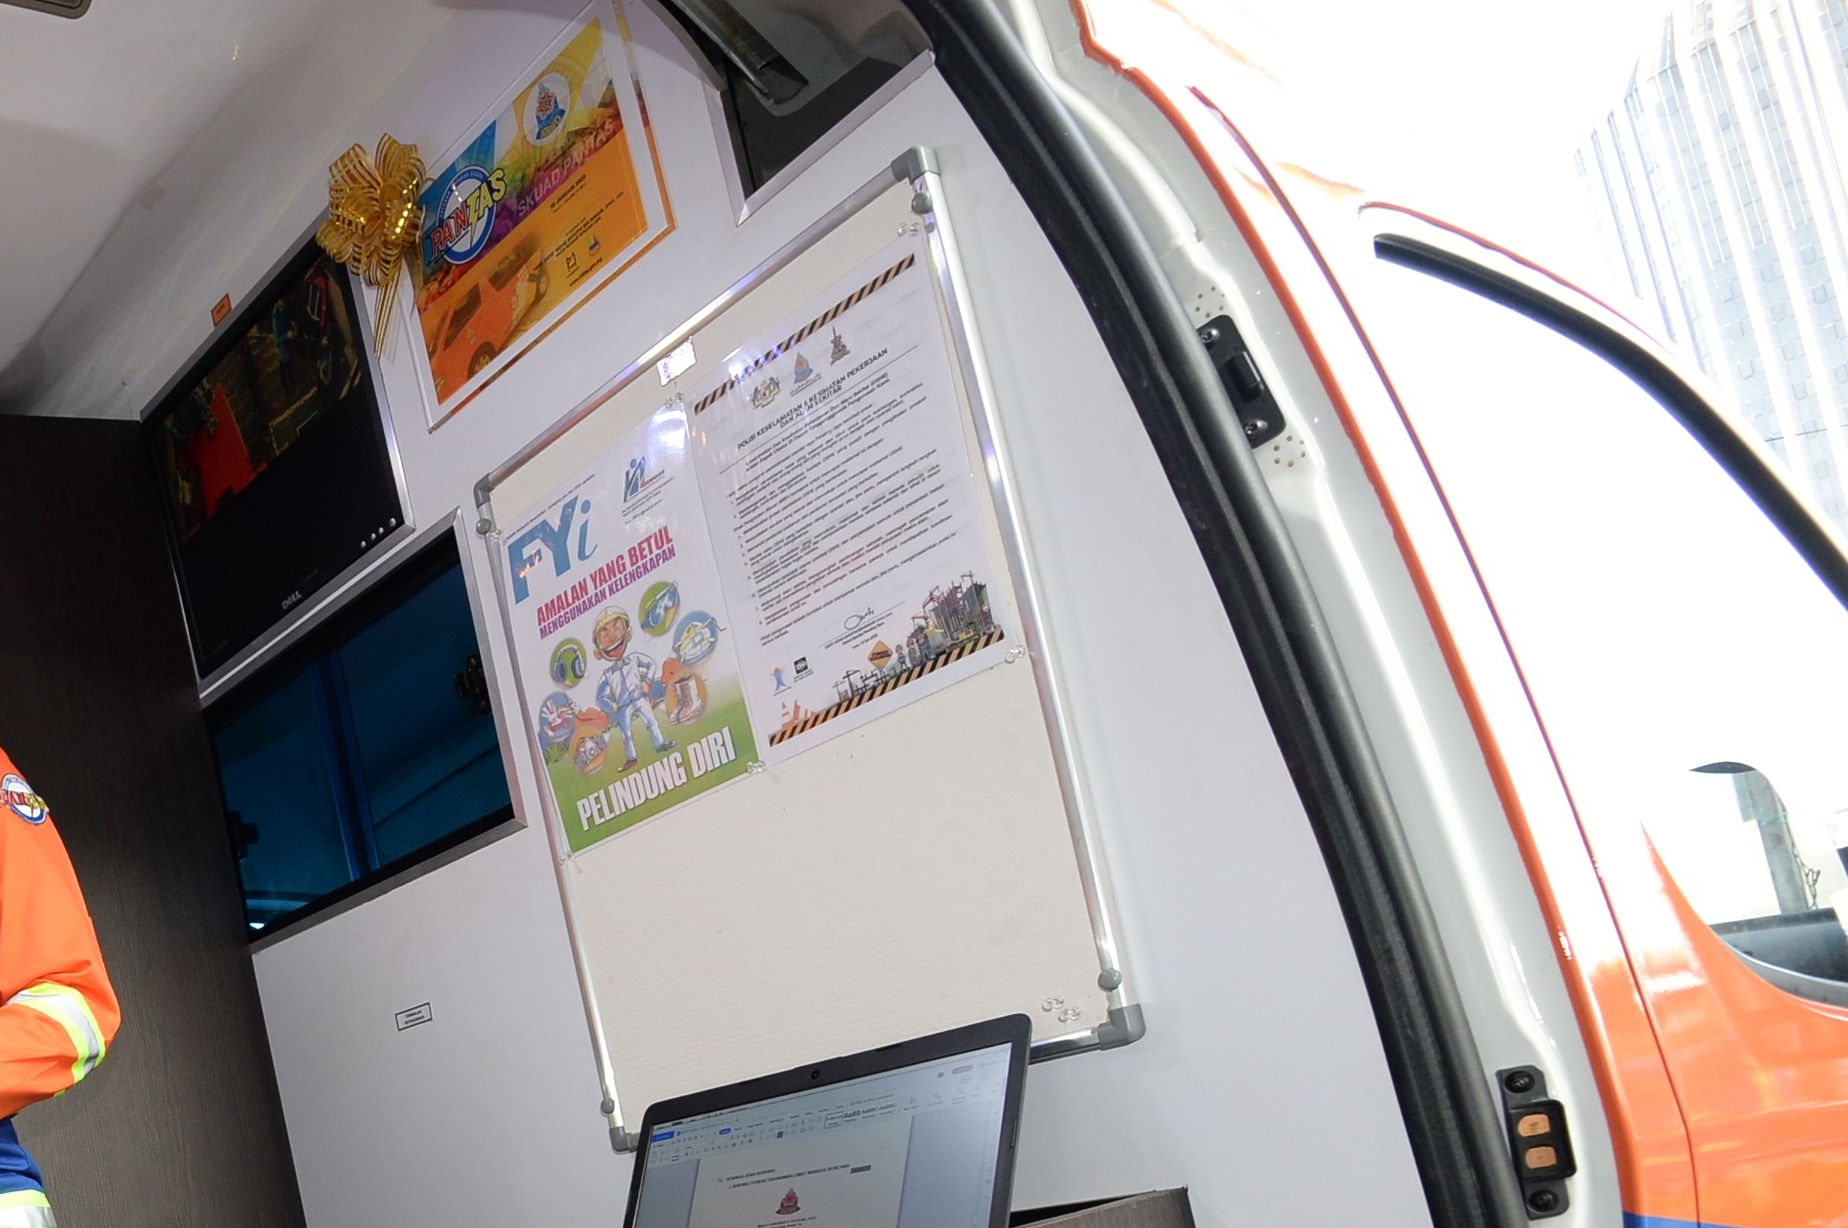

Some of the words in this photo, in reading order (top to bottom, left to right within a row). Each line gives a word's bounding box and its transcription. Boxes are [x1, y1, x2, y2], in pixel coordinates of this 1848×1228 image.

[430, 167, 507, 258] PANTAS
[518, 173, 562, 218] SKUAD
[563, 119, 614, 173] PANTAS
[756, 404, 802, 437] KESELAMATAN
[846, 348, 887, 379] PEKERJAAN
[282, 590, 303, 610] DELL
[536, 577, 588, 626] AMALAN
[590, 553, 626, 591] YANG
[627, 522, 672, 567] BETUL
[539, 586, 606, 640] MENGGUNAKAN
[607, 543, 675, 596] KELENGKAPAN
[576, 752, 687, 831] PELINDUNG
[687, 726, 737, 779] DIRI
